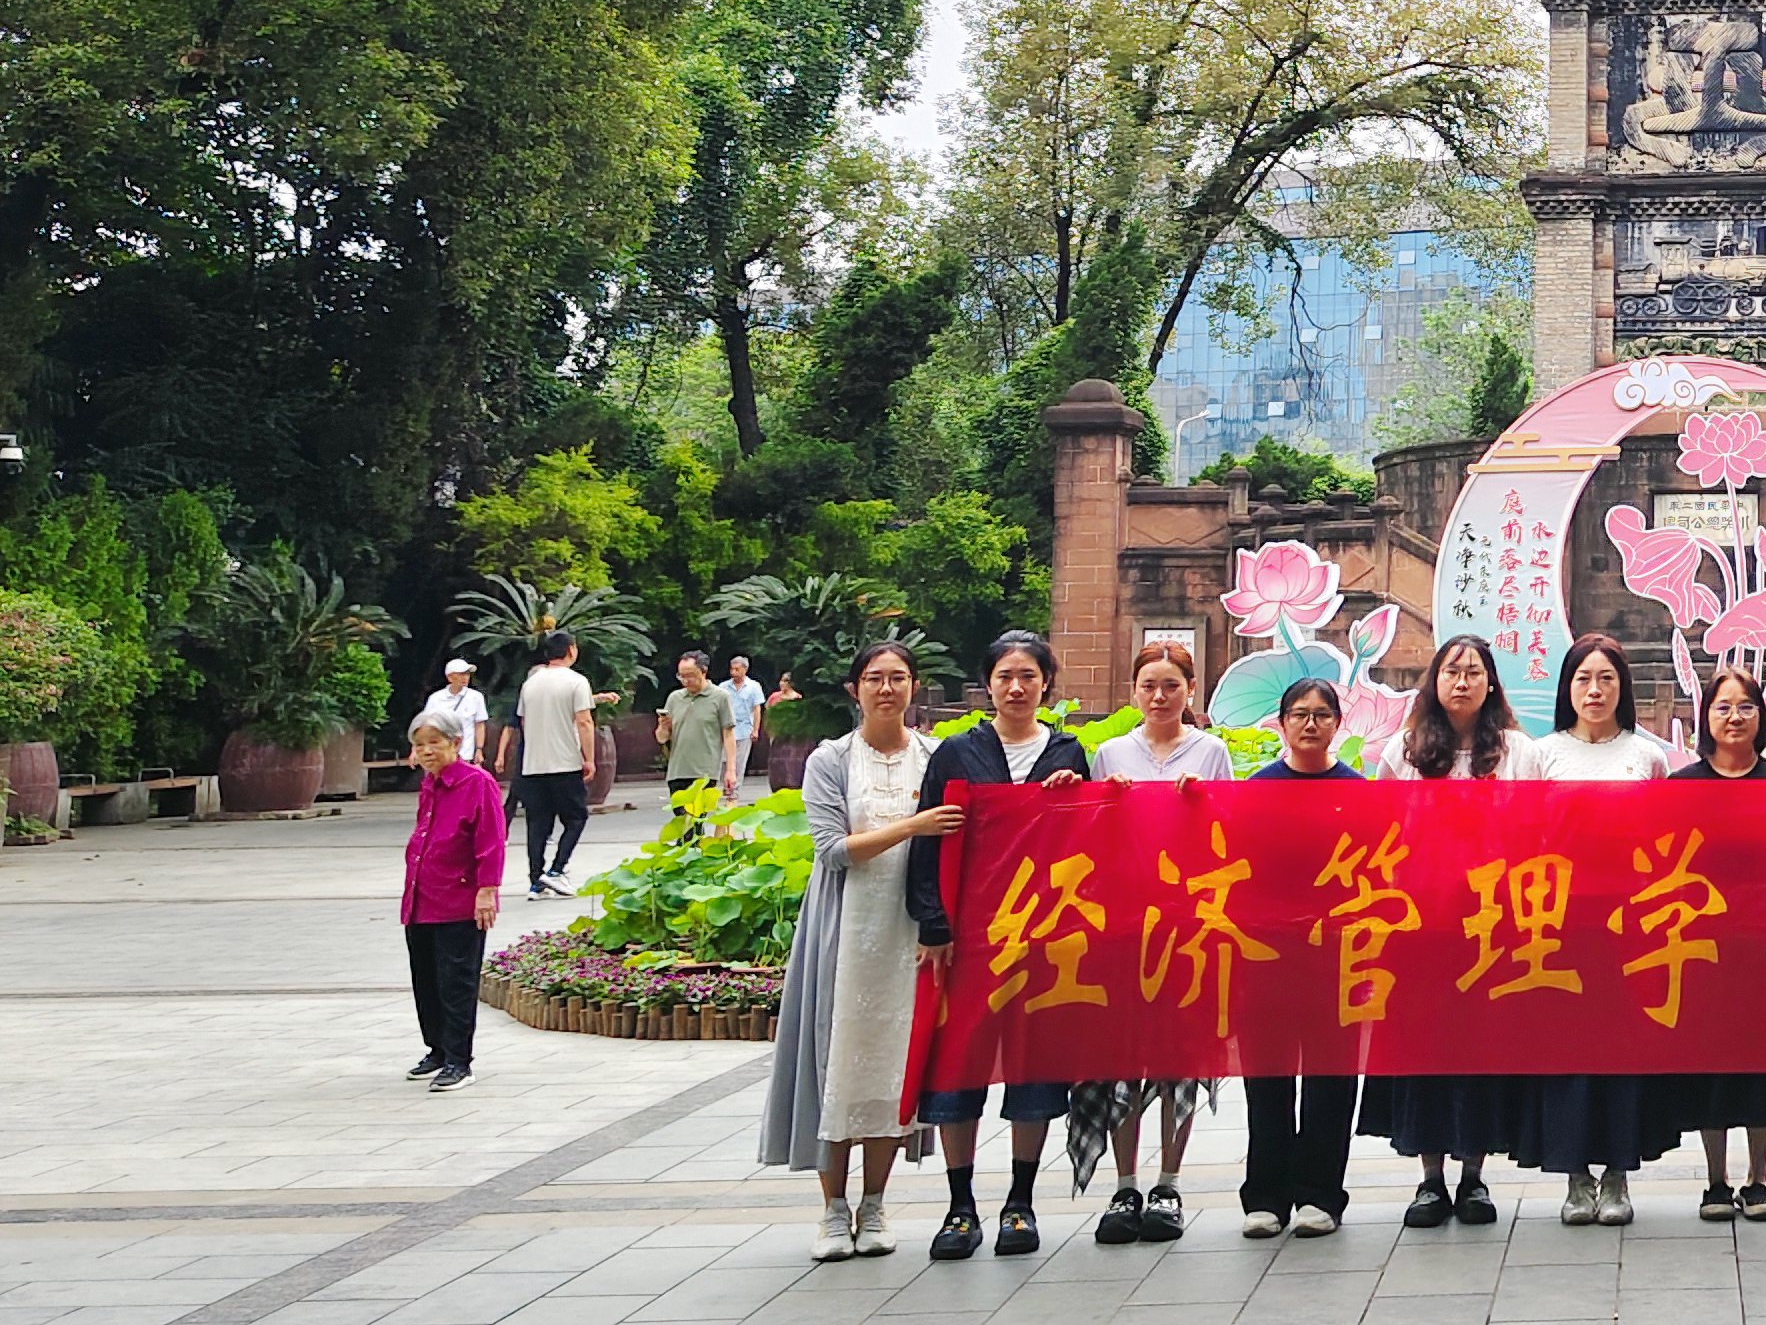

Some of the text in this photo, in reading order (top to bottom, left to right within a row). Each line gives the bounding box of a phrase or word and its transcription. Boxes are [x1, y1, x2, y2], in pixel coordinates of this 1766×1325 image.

[1493, 488, 1526, 655] 庭前落尽梧桐
